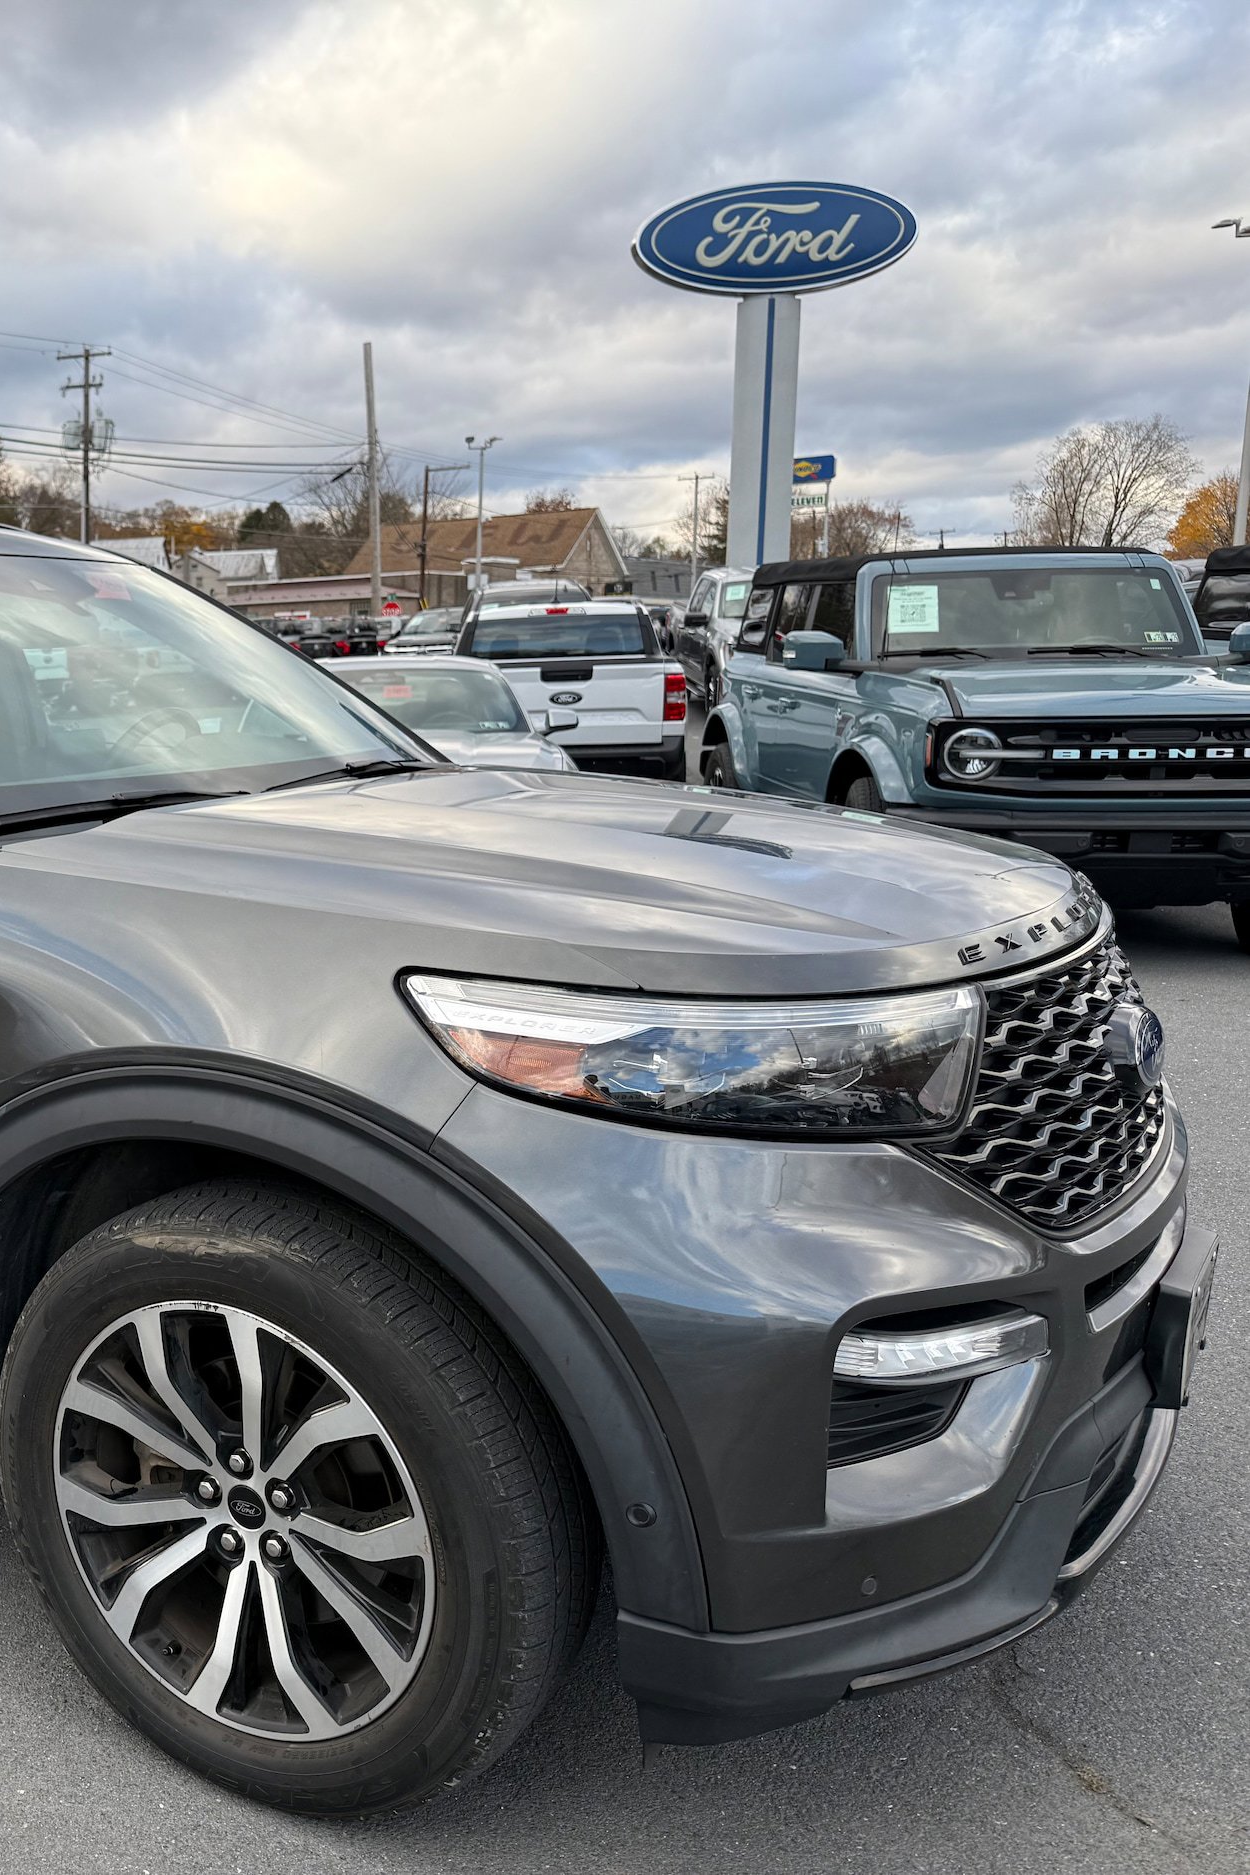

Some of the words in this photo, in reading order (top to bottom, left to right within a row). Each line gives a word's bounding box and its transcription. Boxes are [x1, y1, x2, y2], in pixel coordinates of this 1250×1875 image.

[695, 201, 861, 268] Ford
[382, 608, 400, 617] STOP
[1052, 748, 1250, 760] BRONC
[957, 880, 1094, 965] EXPLOR
[453, 1010, 596, 1035] EXPLORER
[235, 1502, 256, 1515] Ford
